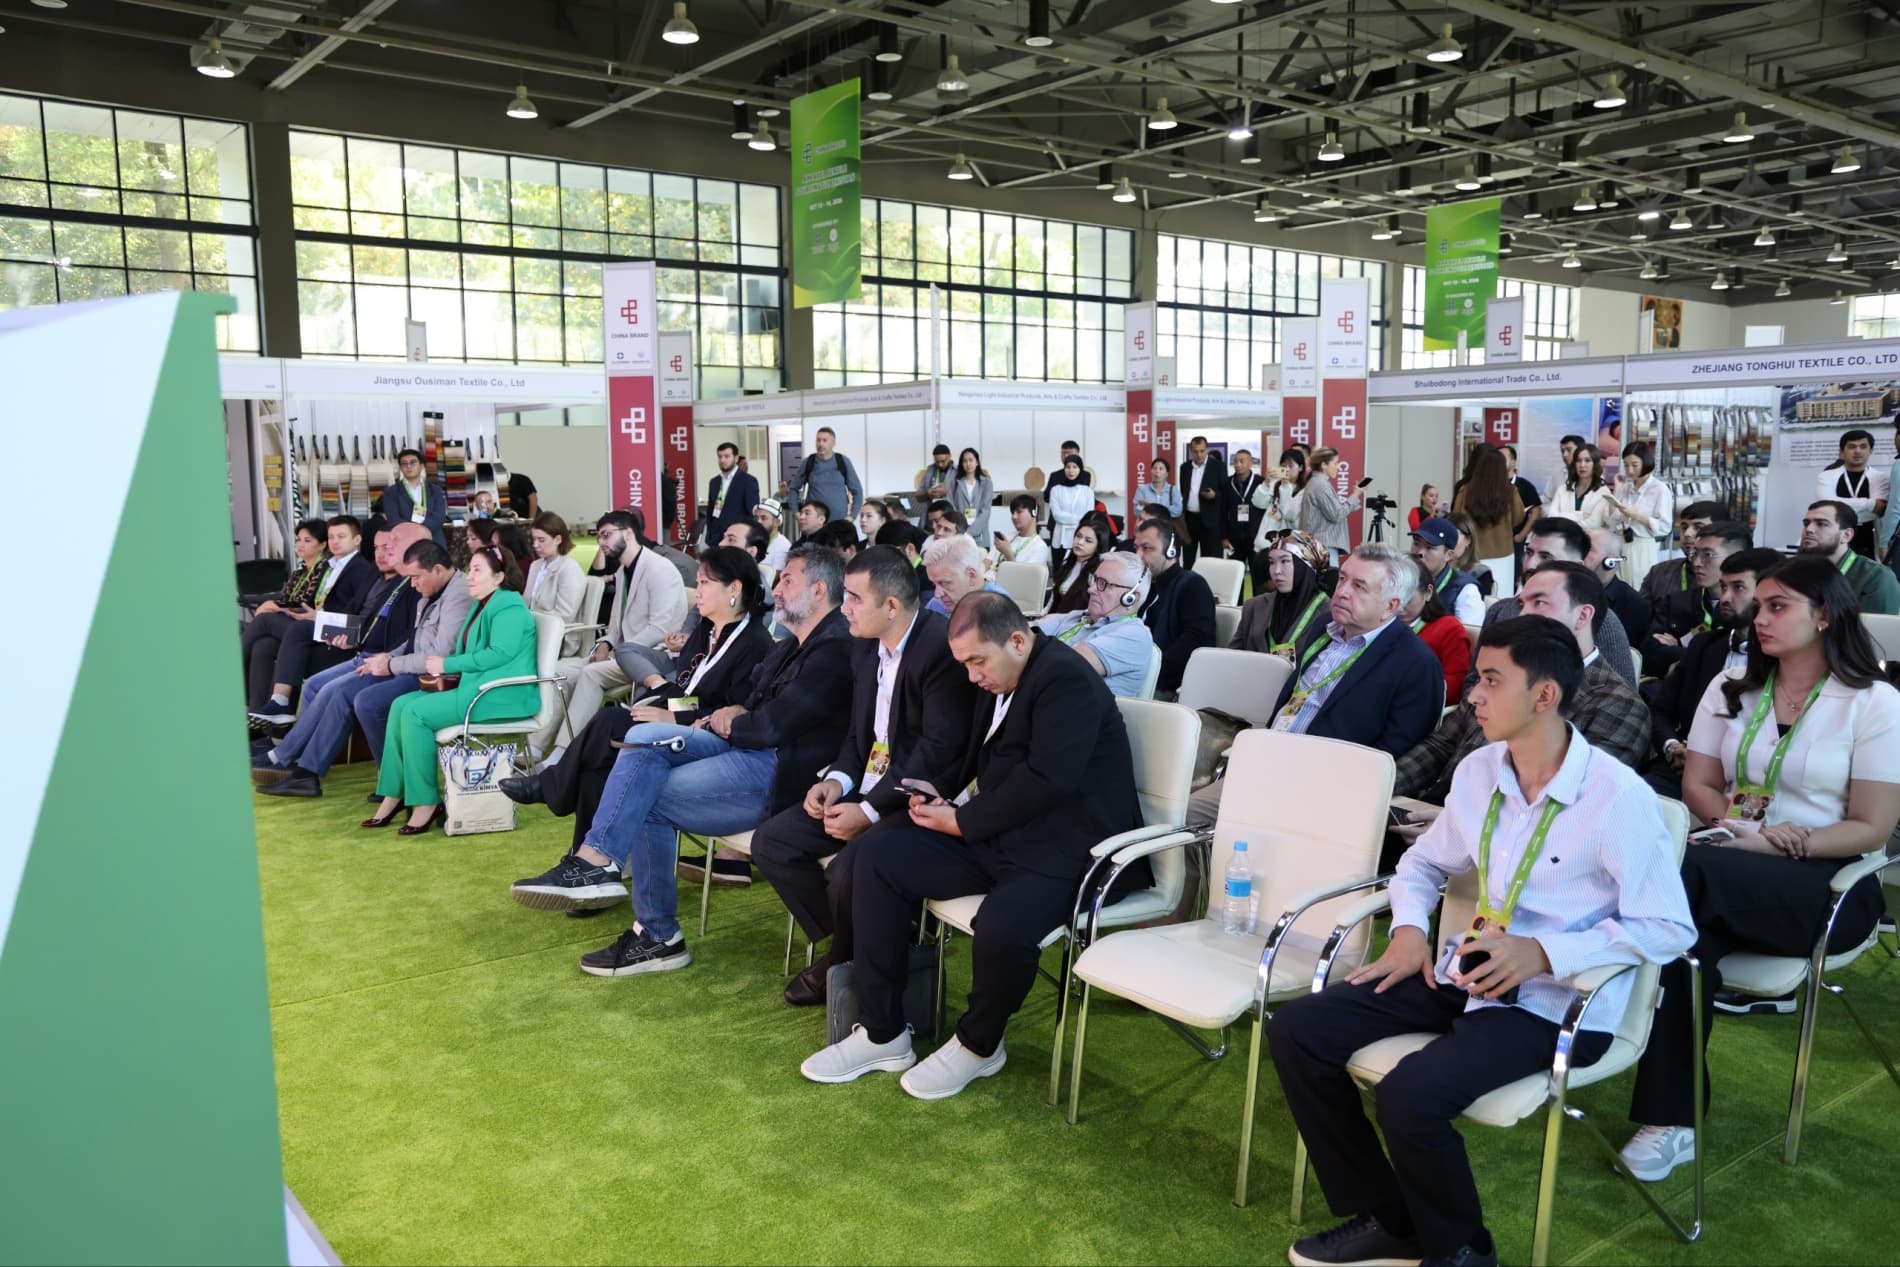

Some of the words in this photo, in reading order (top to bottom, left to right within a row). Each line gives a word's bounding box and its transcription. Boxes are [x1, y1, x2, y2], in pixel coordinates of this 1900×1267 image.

[1692, 362, 1743, 374] ZHEJIANG
[1746, 360, 1795, 371] TONGHUI
[1799, 357, 1845, 368] TEXTILE
[1848, 356, 1872, 366] CO.,
[1875, 354, 1898, 364] LTD
[374, 375, 411, 386] Jiangsu
[414, 376, 456, 386] Ousiman
[459, 377, 488, 387] Textile
[490, 378, 508, 388] Co.,
[510, 378, 525, 387] Ltd
[1414, 379, 1456, 388] Shuibodong
[1458, 376, 1504, 386] International
[1506, 375, 1526, 383] Trade
[1529, 374, 1544, 382] Co.,
[1546, 373, 1561, 381] Ltd.
[629, 468, 643, 507] CHIN
[676, 467, 686, 500] CHINA
